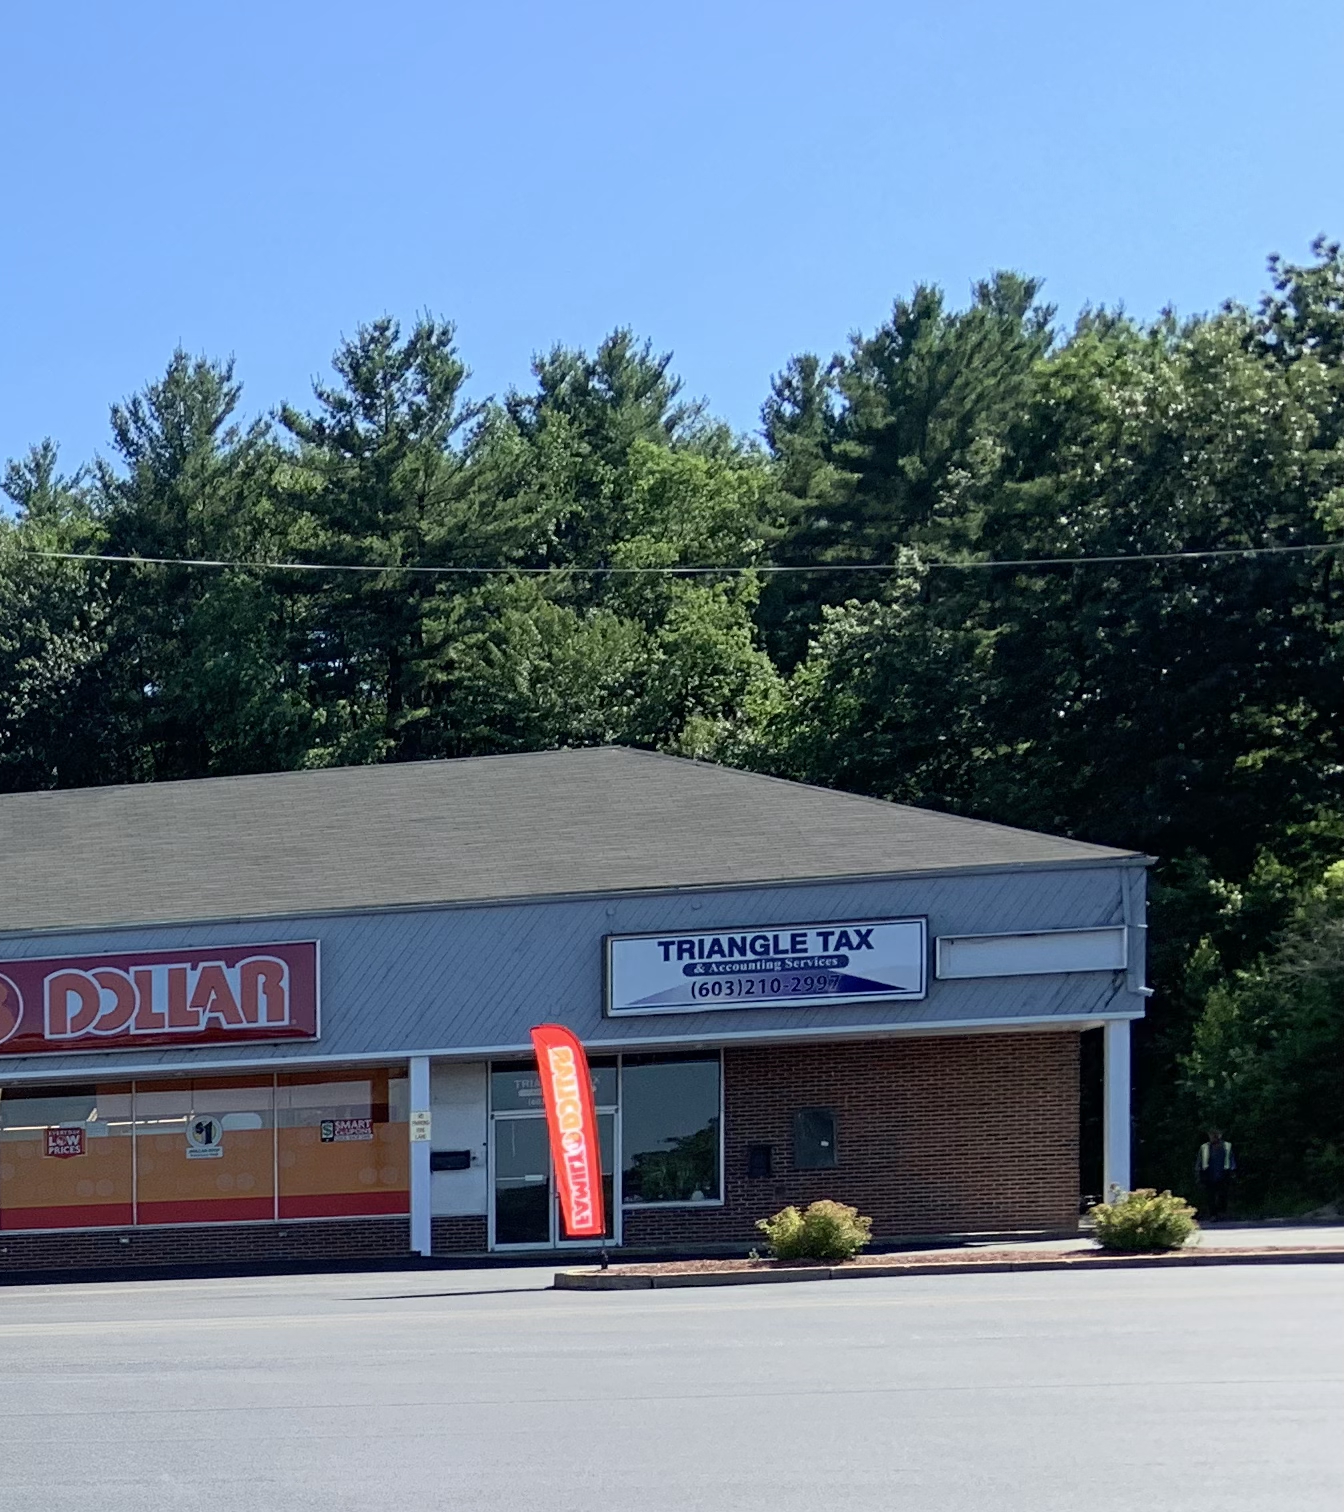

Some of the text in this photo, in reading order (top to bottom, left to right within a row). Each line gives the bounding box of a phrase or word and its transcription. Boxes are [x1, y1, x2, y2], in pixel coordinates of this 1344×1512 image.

[658, 928, 875, 962] TRIANGLE TAX
[693, 956, 839, 974] & Accounting Services
[44, 955, 290, 1039] DOLLAR
[691, 974, 841, 999] (603)210-2997
[334, 1120, 371, 1129] SMART
[48, 1145, 81, 1155] PRICES
